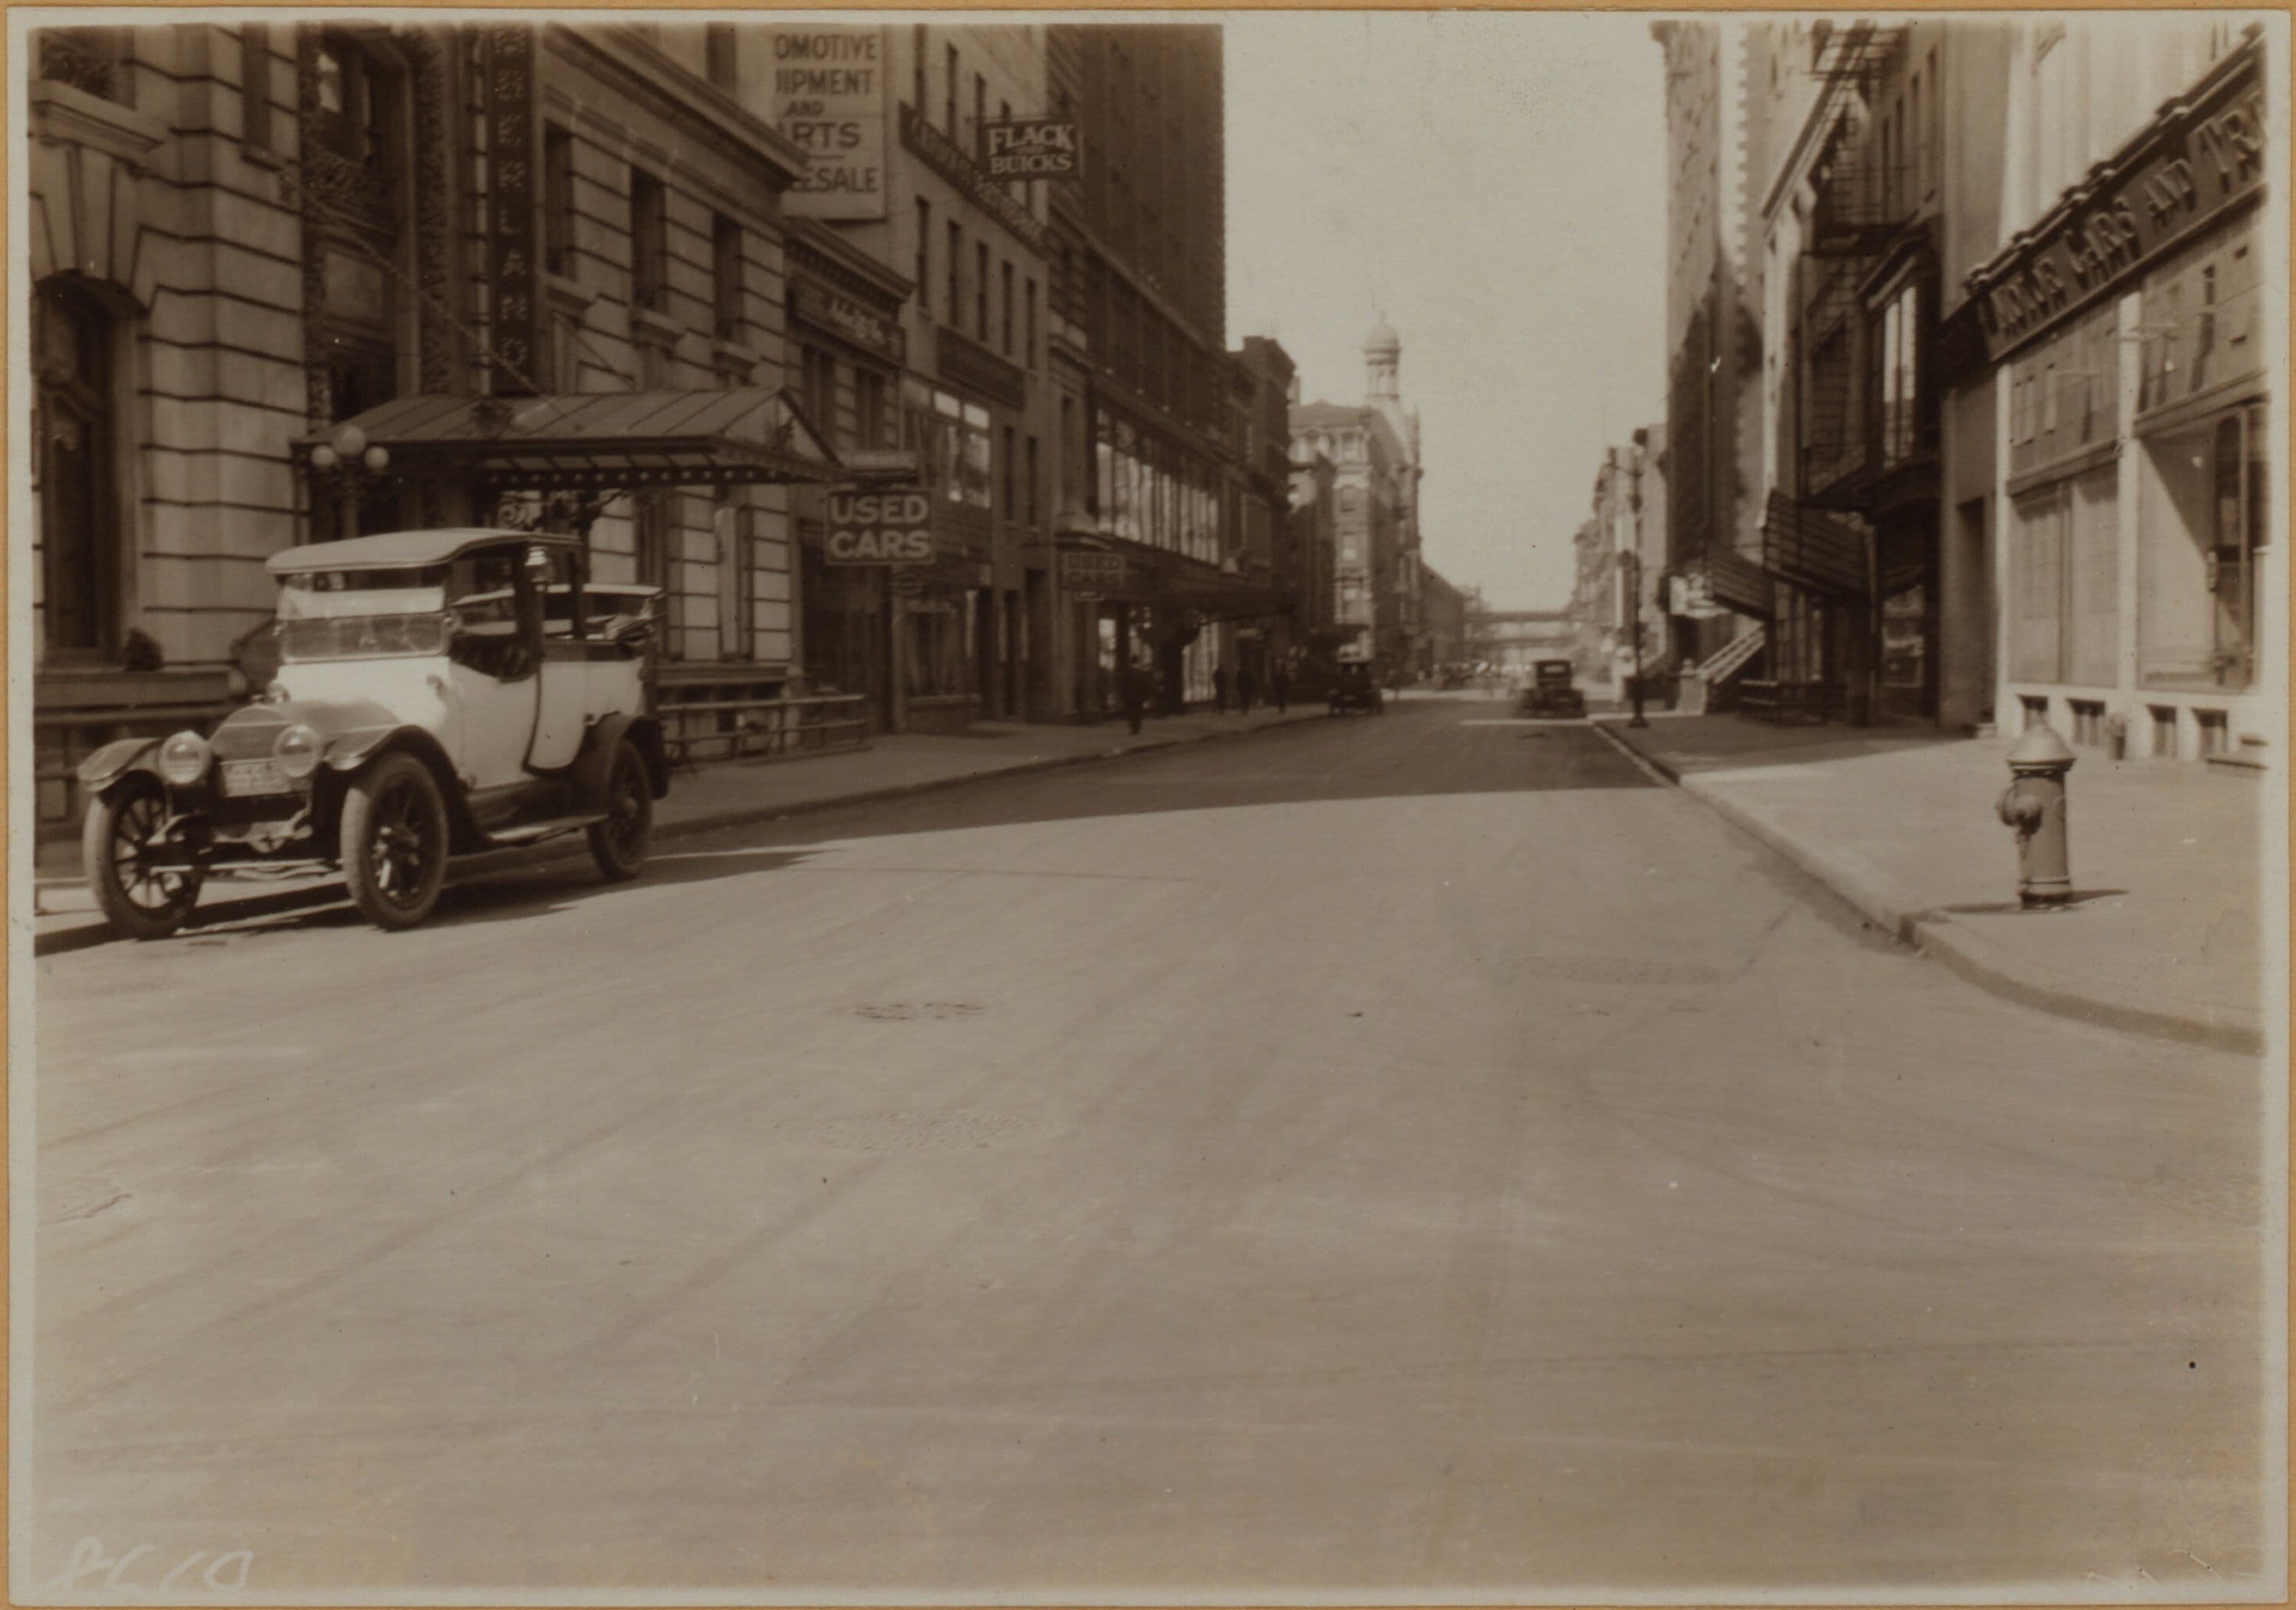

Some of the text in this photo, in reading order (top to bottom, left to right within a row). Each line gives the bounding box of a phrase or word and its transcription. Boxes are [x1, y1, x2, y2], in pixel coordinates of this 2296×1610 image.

[786, 100, 825, 118] AND
[988, 123, 1075, 156] FLACK
[990, 152, 1073, 174] BUICKS
[829, 494, 930, 525] USED
[829, 530, 931, 560] CARS
